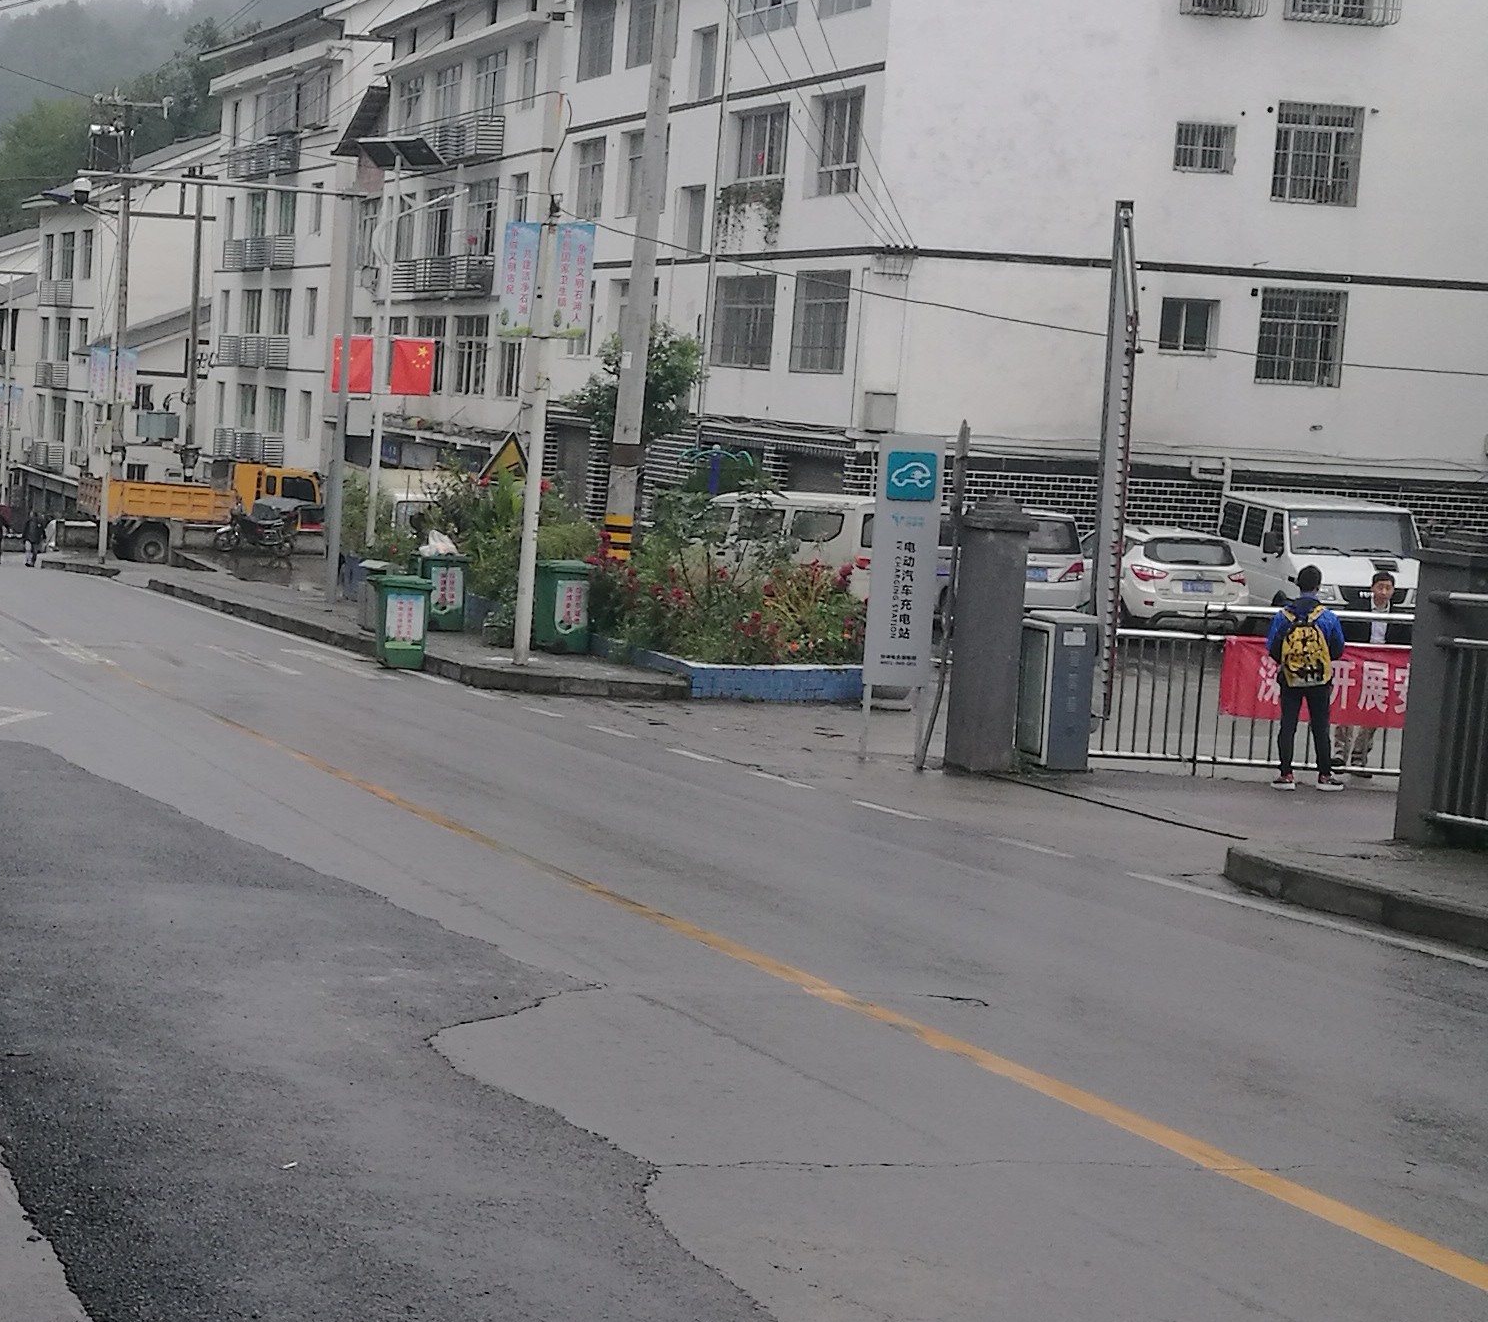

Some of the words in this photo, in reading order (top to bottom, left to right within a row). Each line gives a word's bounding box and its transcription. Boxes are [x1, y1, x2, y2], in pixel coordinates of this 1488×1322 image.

[892, 556, 902, 601] CHARGING
[898, 541, 915, 639] 电动汽车充电站
[890, 603, 899, 639] STATION
